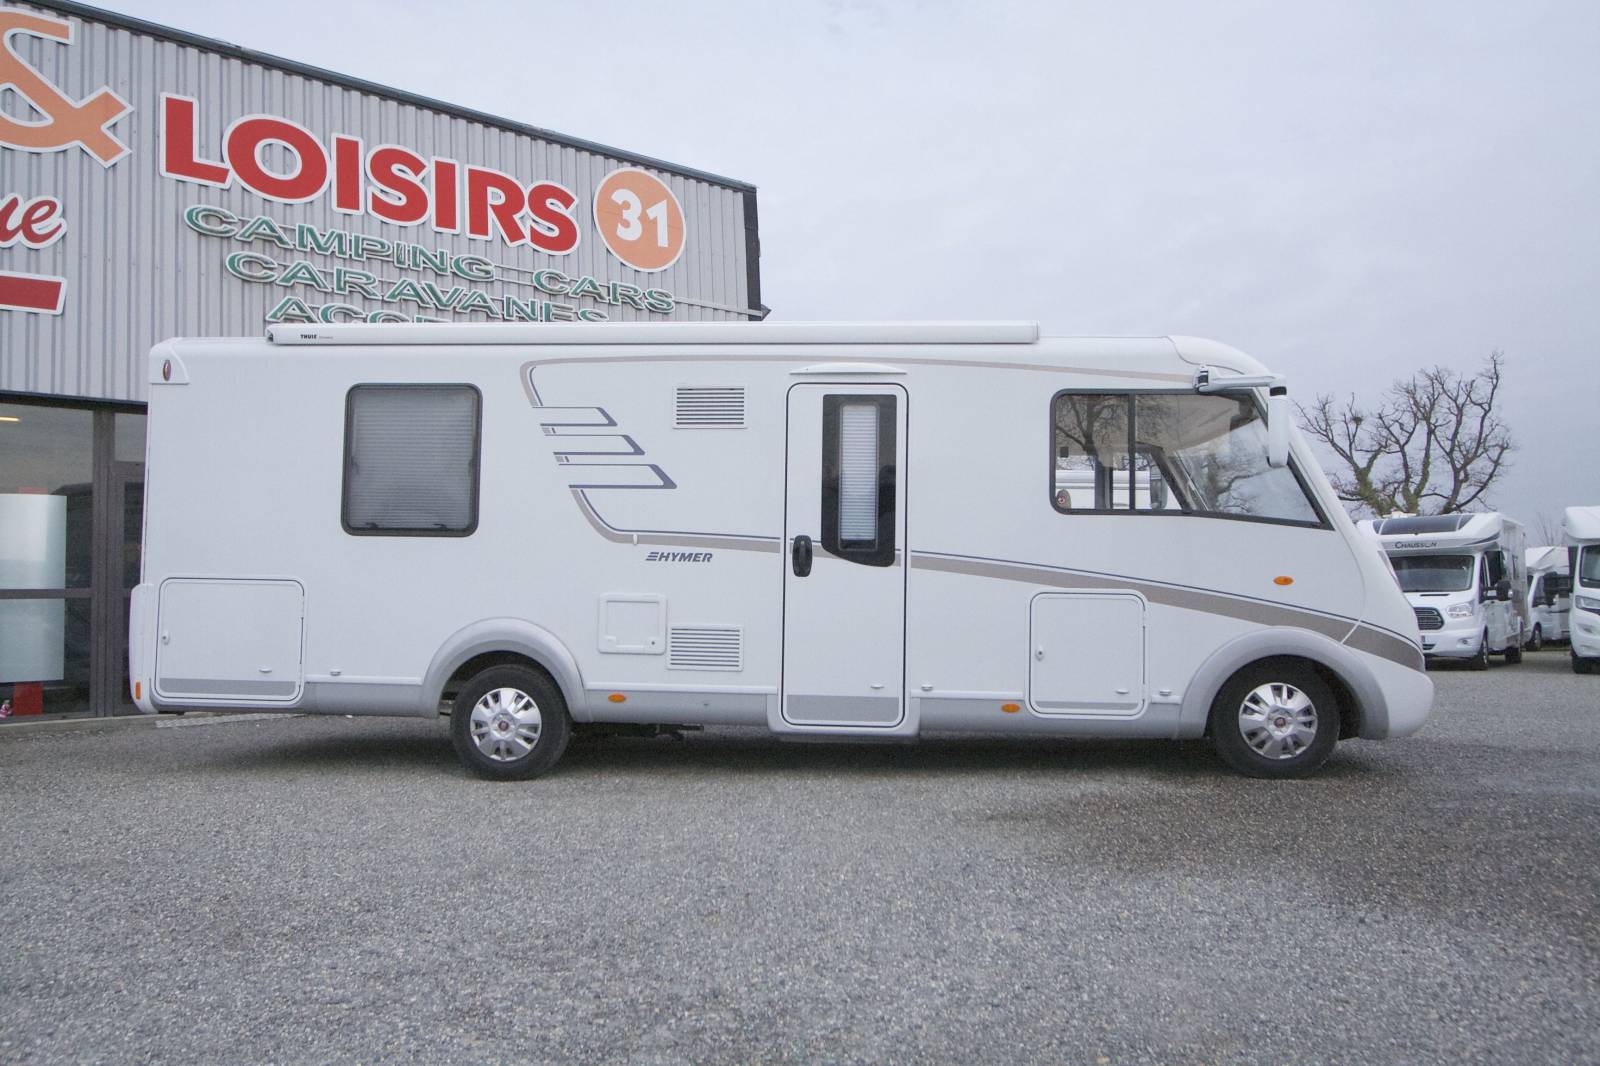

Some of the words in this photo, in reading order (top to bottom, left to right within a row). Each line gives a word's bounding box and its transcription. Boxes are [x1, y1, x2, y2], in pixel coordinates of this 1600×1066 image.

[161, 93, 579, 255] LOISIRS
[611, 189, 668, 247] 31
[184, 204, 495, 281] CAMPING
[533, 268, 676, 313] CARS
[225, 251, 609, 322] CARAVANES
[658, 552, 713, 562] HYMER
